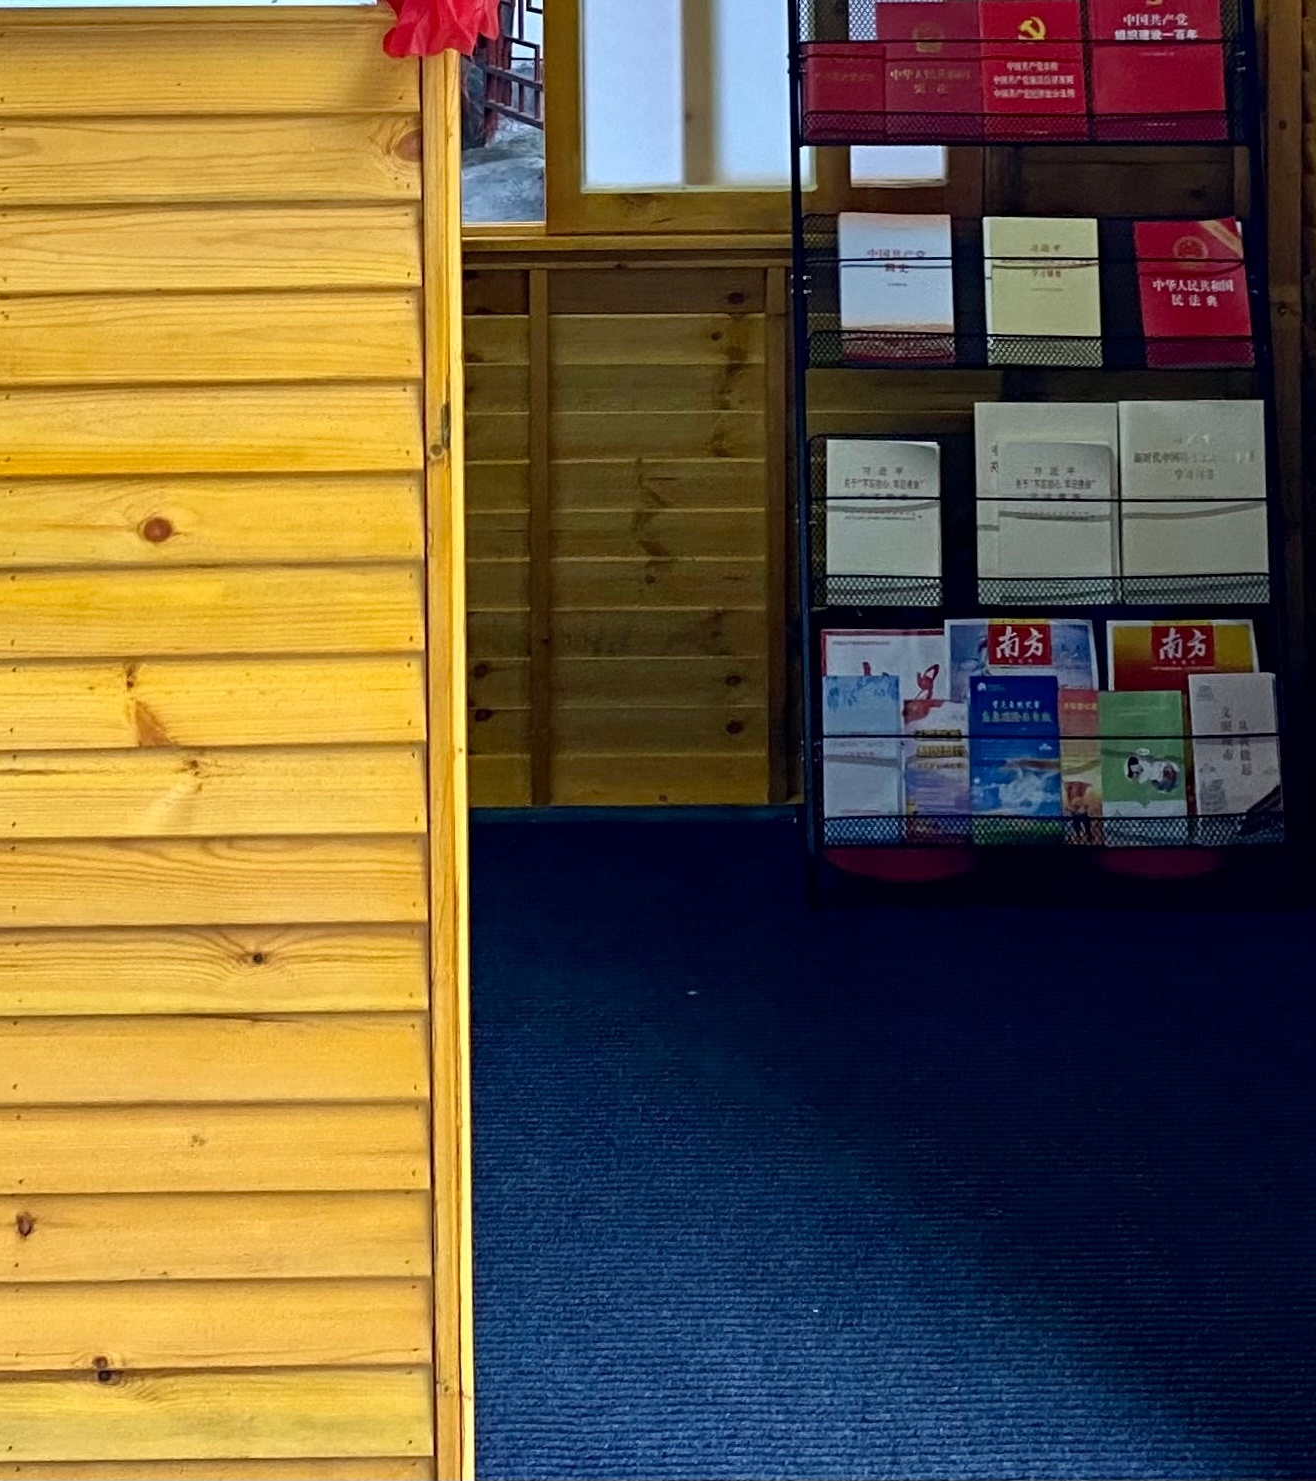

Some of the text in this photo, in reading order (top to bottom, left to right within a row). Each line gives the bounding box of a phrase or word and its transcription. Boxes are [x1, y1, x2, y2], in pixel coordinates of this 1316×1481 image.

[1122, 13, 1189, 27] 中国共产党
[1152, 278, 1235, 293] 中华人民共和国
[1171, 294, 1220, 307] 民法典
[995, 625, 1045, 659] 南方
[1158, 626, 1208, 661] 南方
